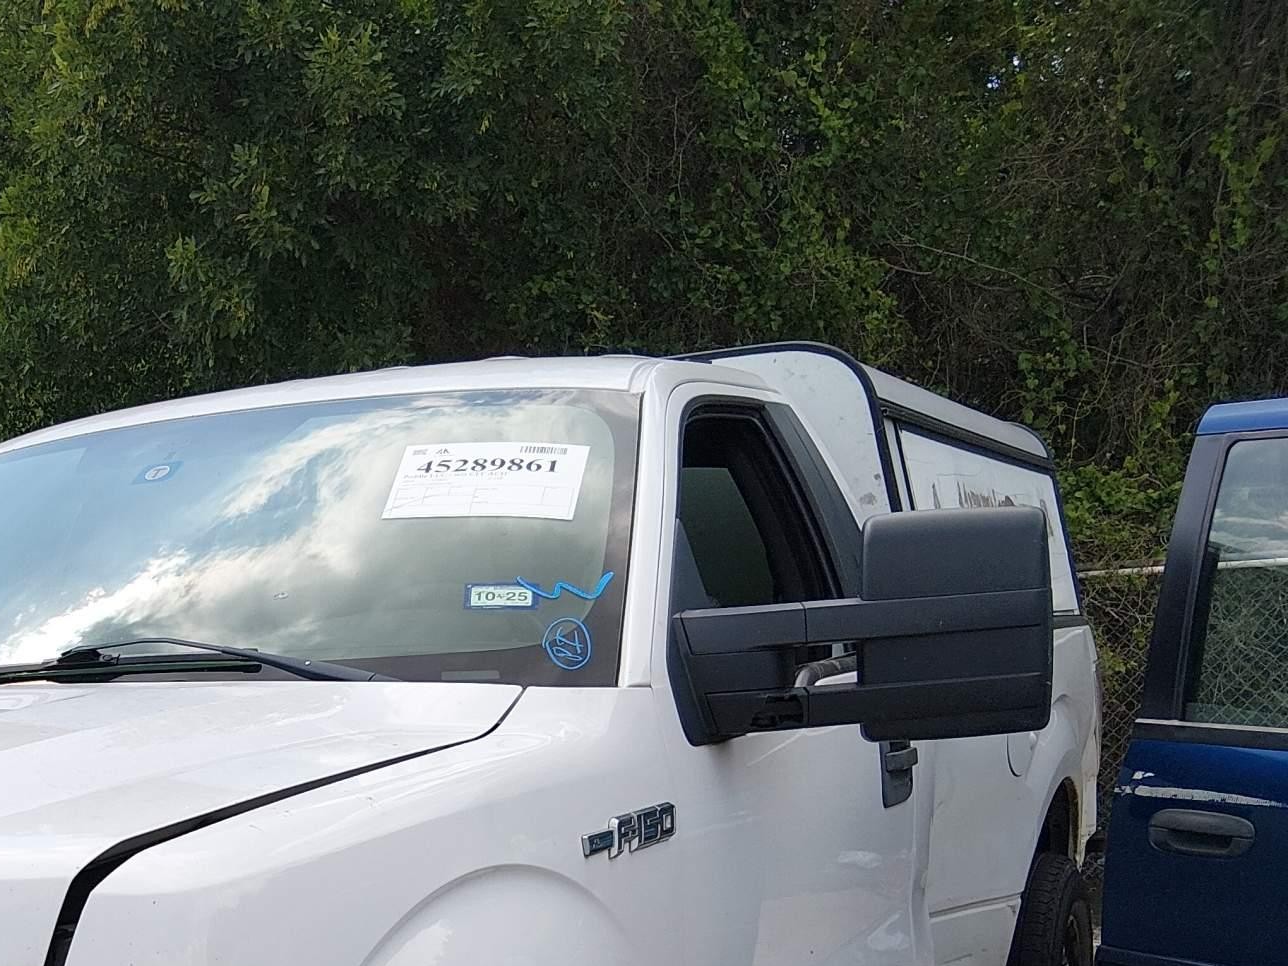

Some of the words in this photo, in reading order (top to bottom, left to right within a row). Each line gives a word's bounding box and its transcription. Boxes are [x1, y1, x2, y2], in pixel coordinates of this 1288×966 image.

[416, 457, 560, 474] 45289861
[475, 591, 496, 602] 10
[506, 591, 528, 602] 25
